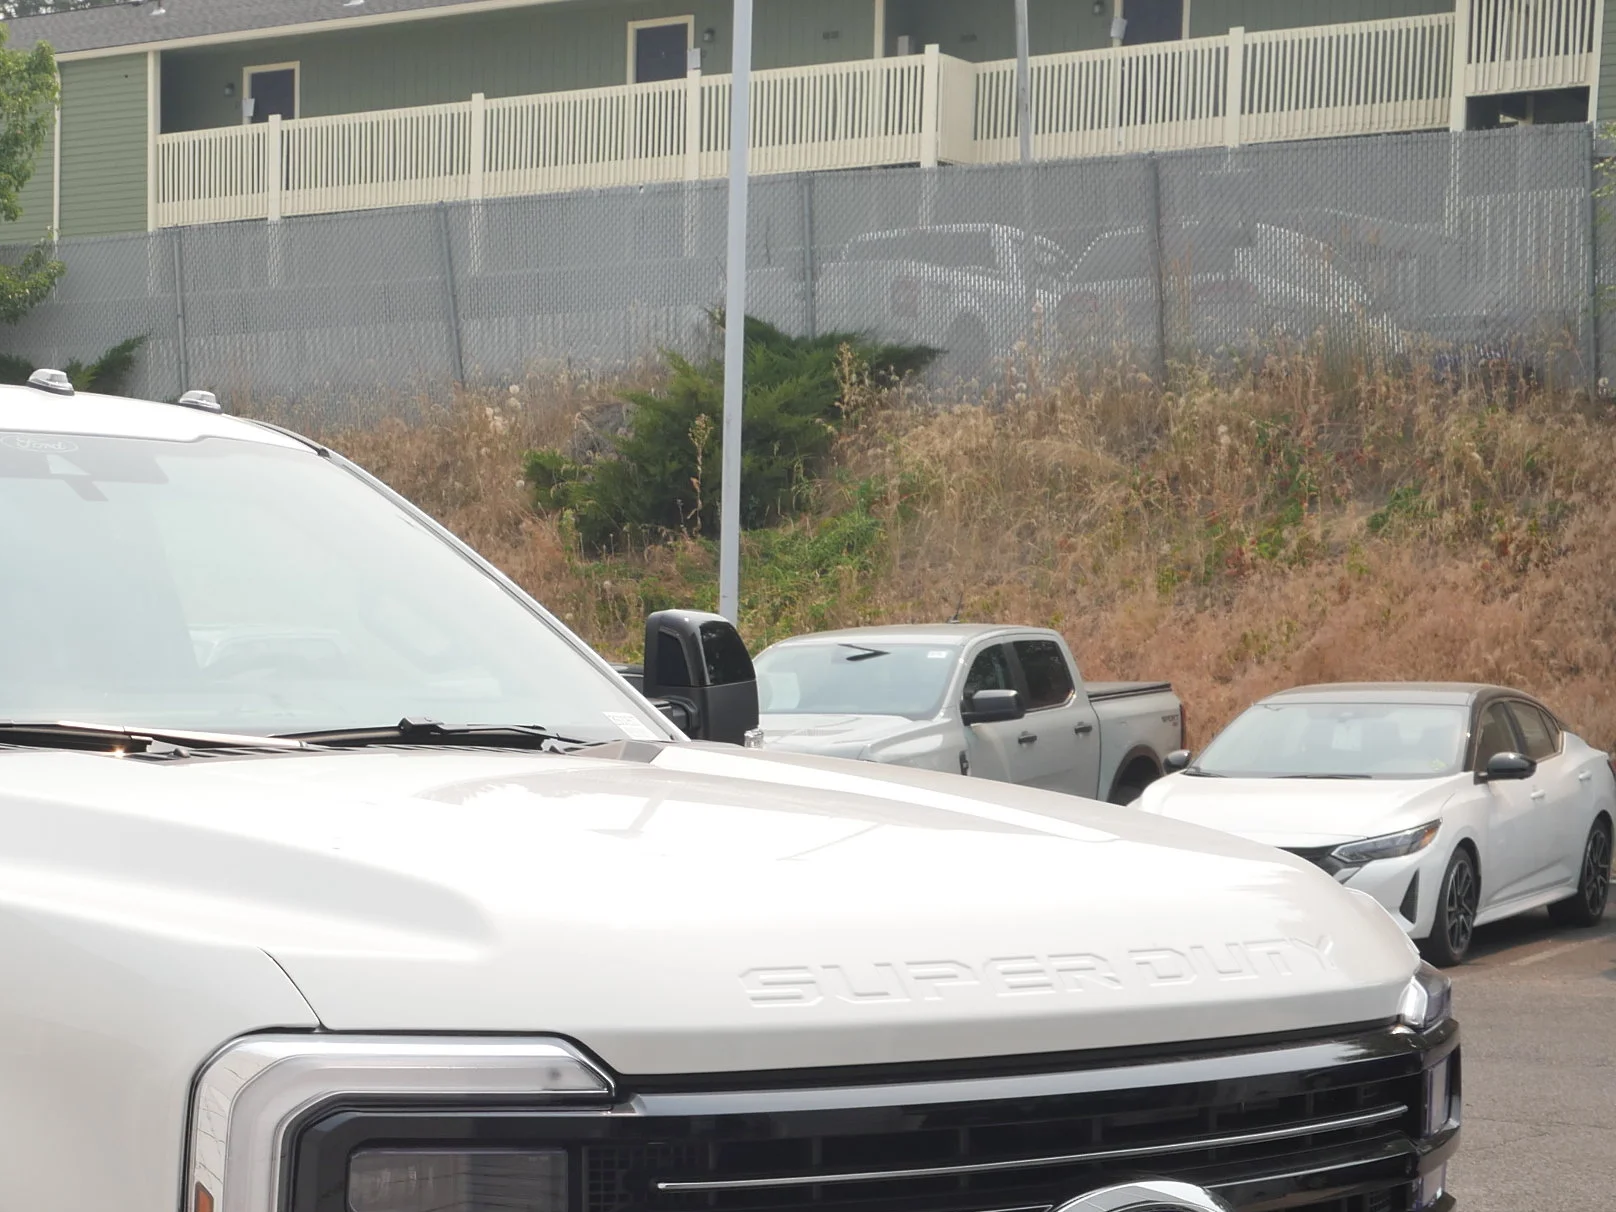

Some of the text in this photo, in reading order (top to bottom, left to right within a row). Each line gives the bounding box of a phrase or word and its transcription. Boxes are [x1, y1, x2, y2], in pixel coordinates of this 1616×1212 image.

[14, 434, 67, 450] Ford
[739, 935, 1338, 1008] SUPER DUTY
